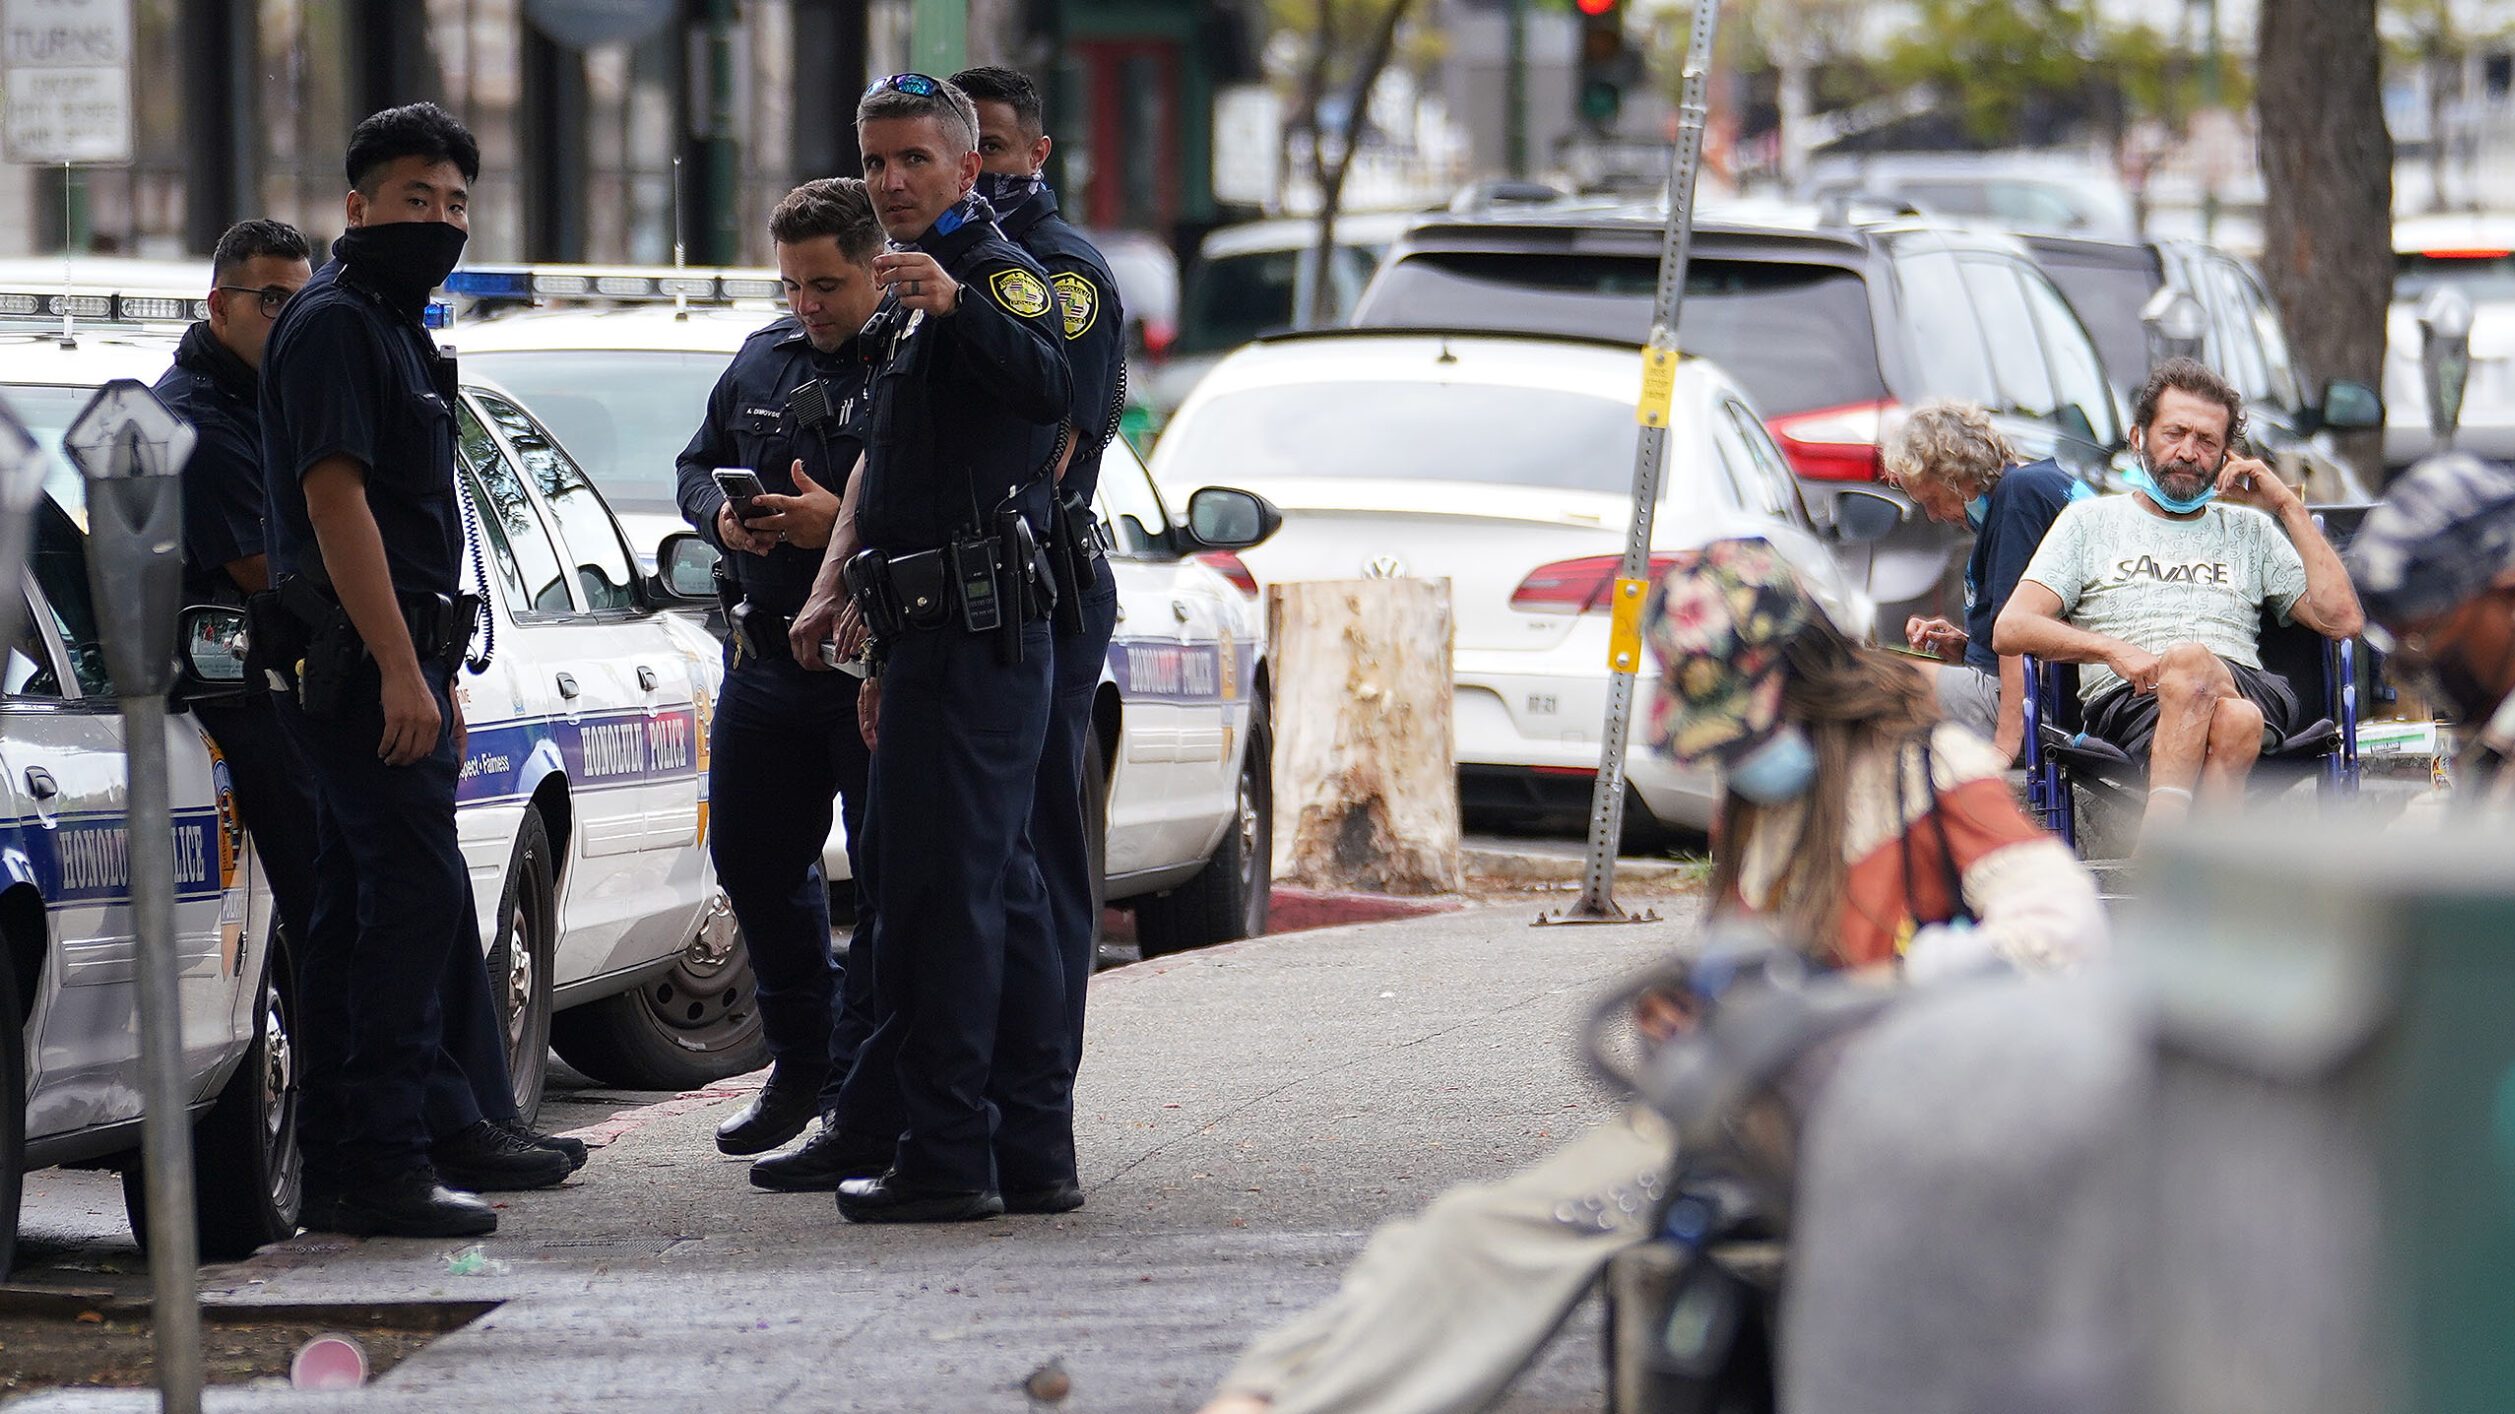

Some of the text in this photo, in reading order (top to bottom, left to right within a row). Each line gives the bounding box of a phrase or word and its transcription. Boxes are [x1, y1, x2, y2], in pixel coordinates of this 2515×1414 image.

[2112, 555, 2228, 585] SAVAGE
[1126, 648, 1214, 695] HONOLULU POLICE
[580, 719, 686, 777] HONOLULU POLICE
[58, 825, 206, 890] HONOLU LICE
